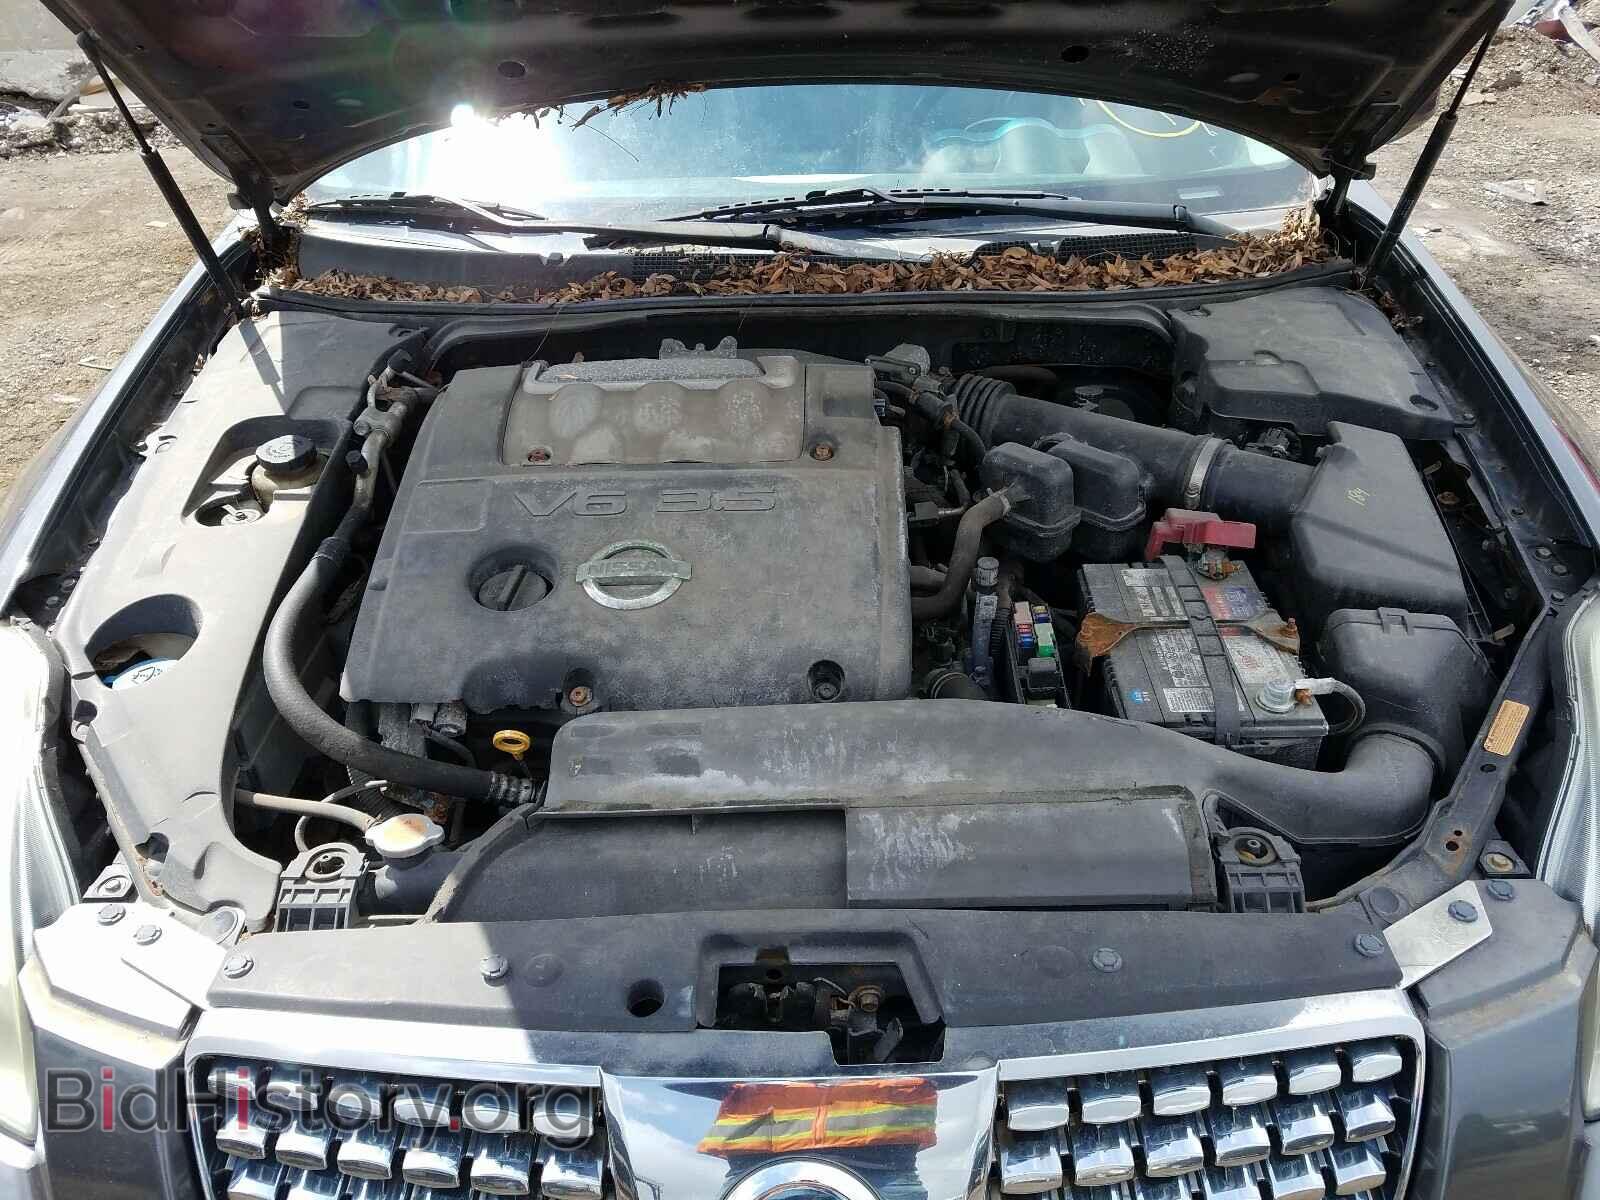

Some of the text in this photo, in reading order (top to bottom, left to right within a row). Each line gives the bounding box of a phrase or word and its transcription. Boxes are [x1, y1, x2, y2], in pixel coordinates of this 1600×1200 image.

[513, 488, 777, 517] V6 3.5
[587, 560, 673, 576] NISSA
